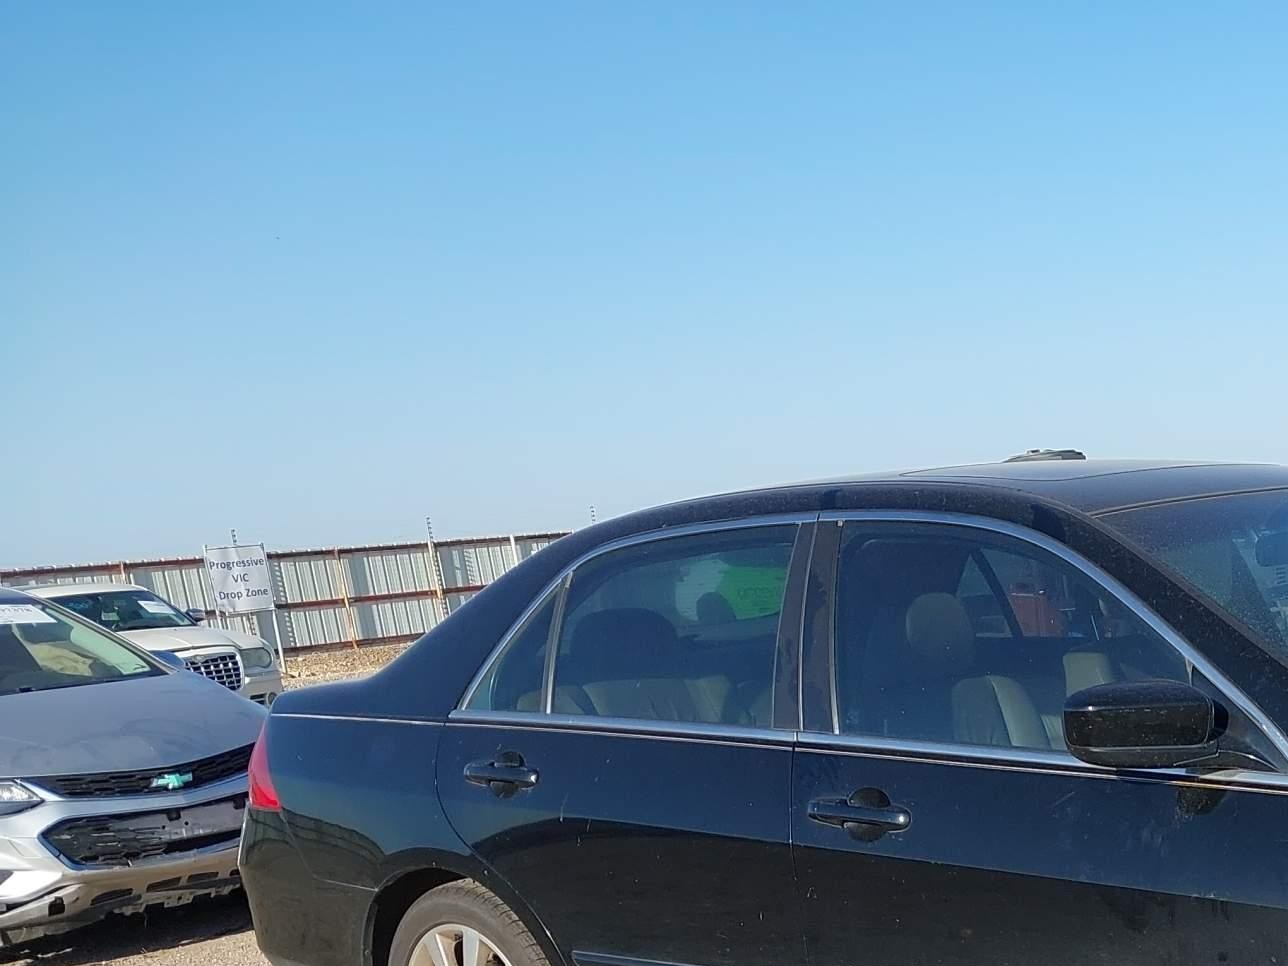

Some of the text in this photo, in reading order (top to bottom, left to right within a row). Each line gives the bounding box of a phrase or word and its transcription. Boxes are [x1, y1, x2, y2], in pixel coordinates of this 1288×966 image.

[208, 557, 265, 571] Progressive
[232, 572, 249, 583] VIC
[218, 588, 269, 601] Drop Zone
